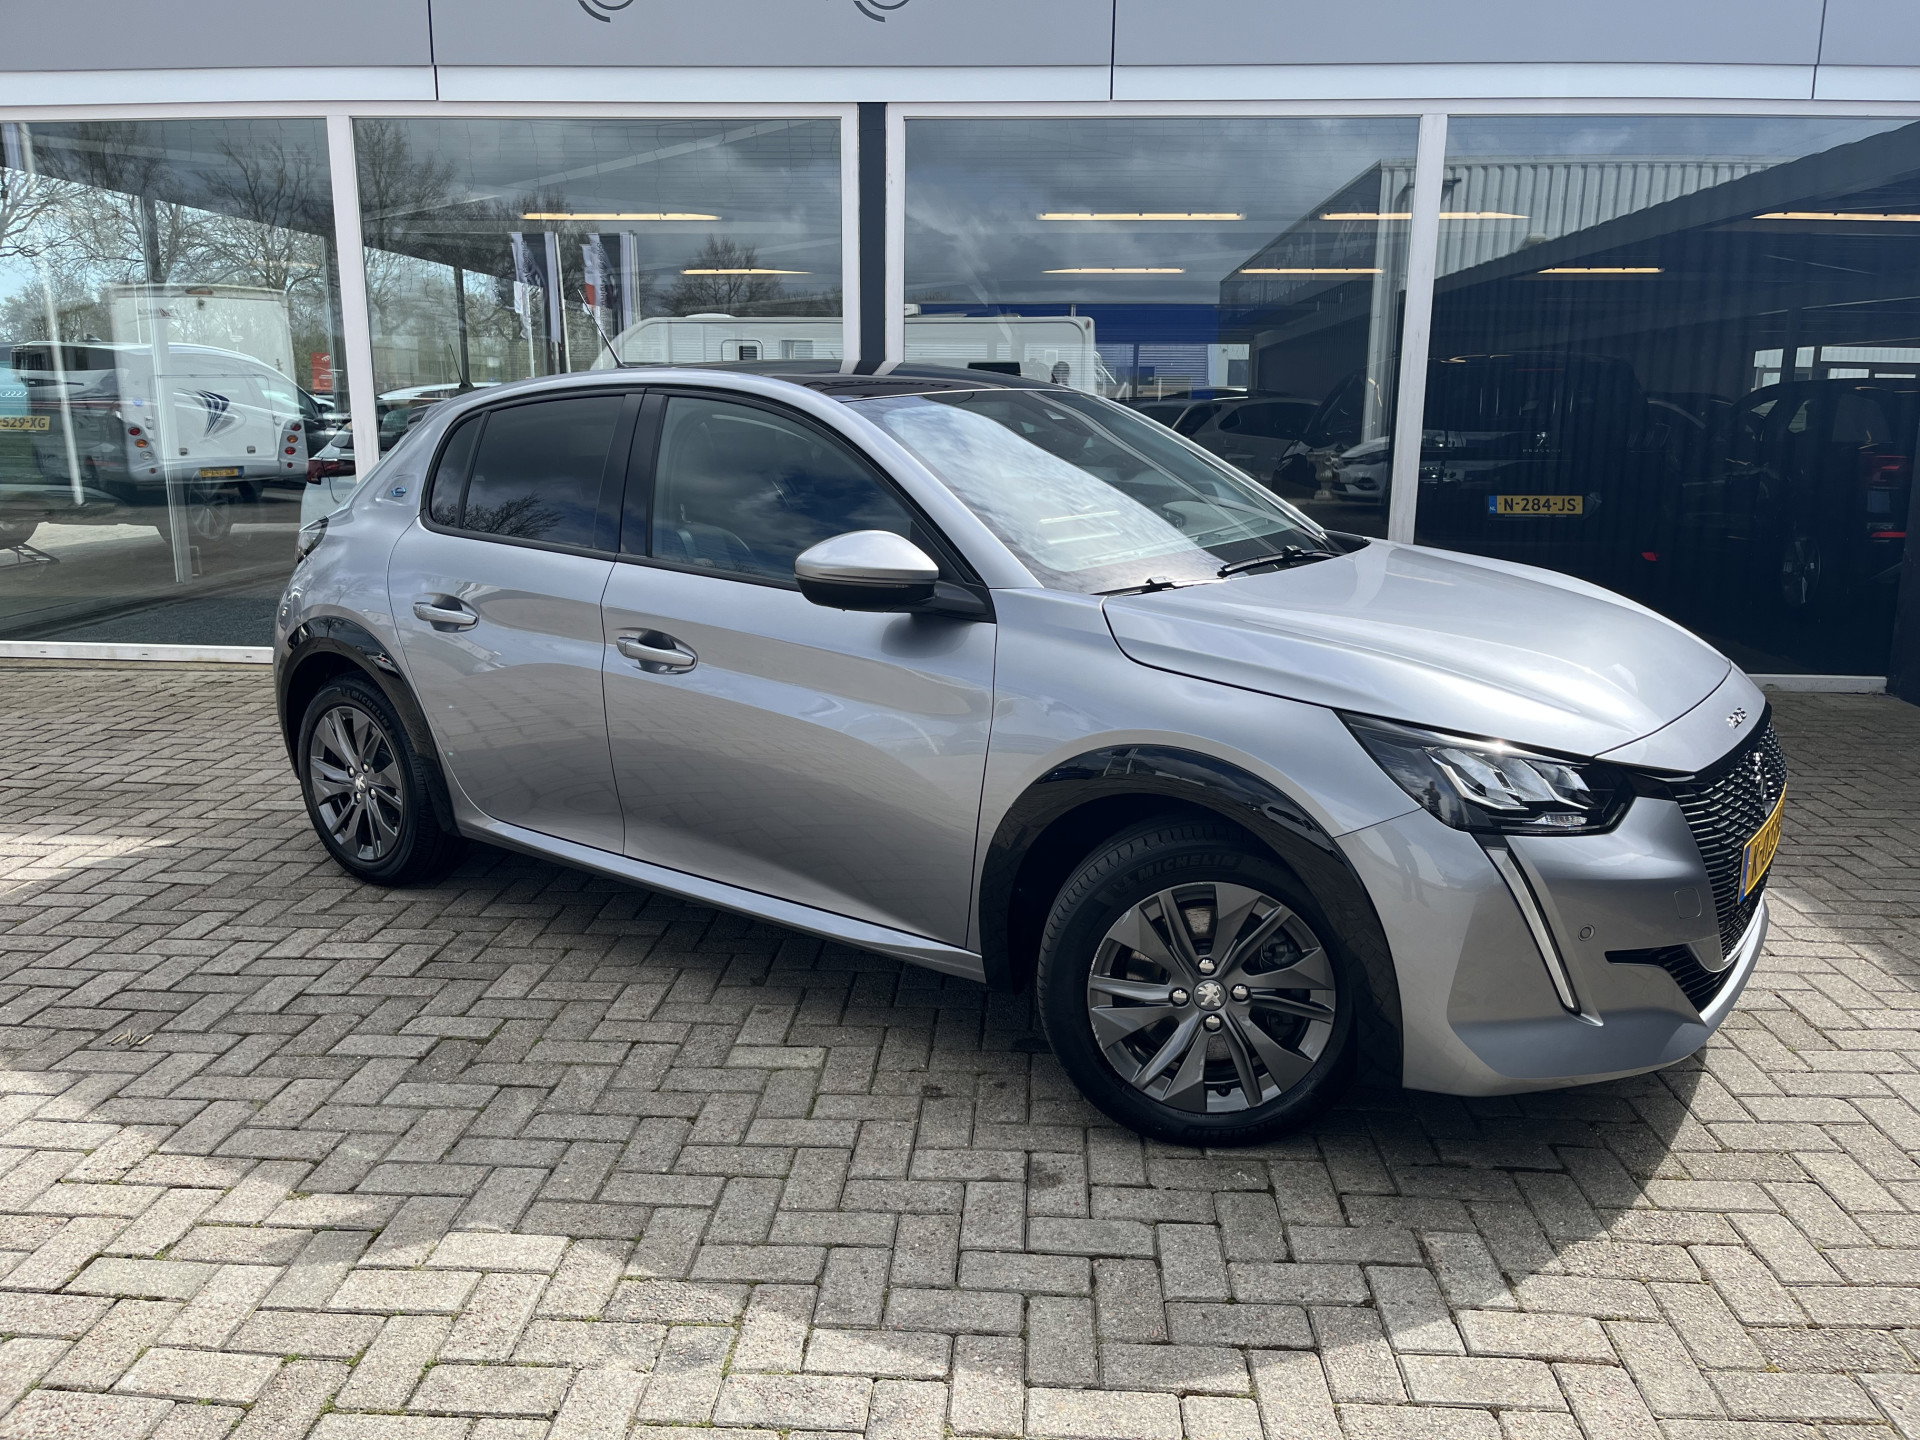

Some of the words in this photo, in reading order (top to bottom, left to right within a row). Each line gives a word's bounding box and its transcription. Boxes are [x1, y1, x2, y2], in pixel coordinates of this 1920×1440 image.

[1503, 497, 1577, 512] N-284-JS
[351, 690, 392, 731] MICHELIN
[1137, 853, 1241, 882] MICHELIN
